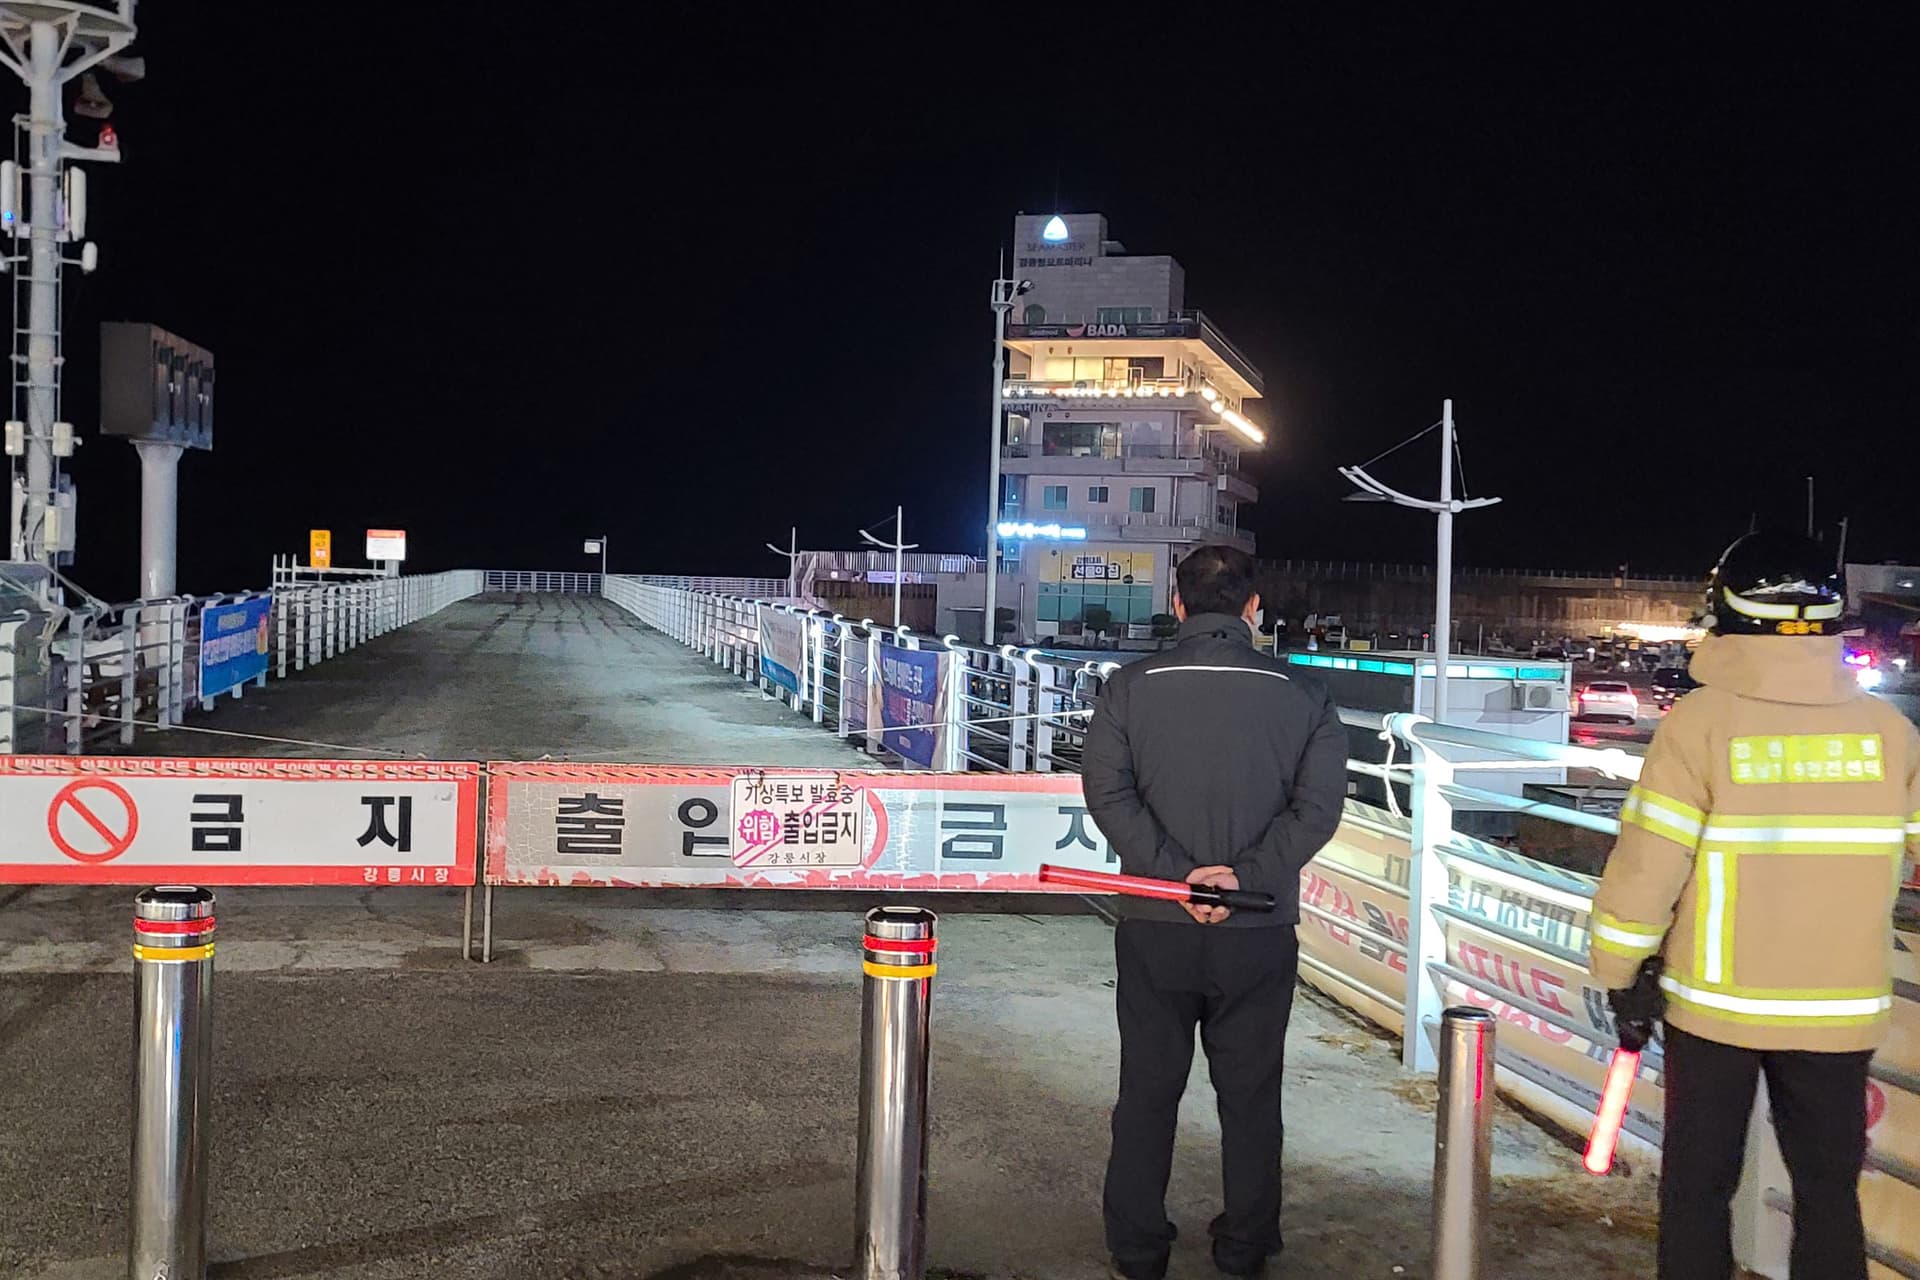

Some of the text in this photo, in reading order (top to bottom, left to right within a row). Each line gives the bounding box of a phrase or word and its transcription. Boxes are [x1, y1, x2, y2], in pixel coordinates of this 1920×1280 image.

[1087, 324, 1127, 336] BADA
[745, 783, 855, 805] 기상특보 발효중
[190, 794, 412, 852] 금 지
[555, 792, 626, 855] 출
[941, 802, 1007, 859] 금
[743, 815, 775, 841] 위험
[783, 810, 857, 844] 출입금지
[768, 852, 827, 864] 강릉시장
[363, 867, 449, 882] 강릉시장
